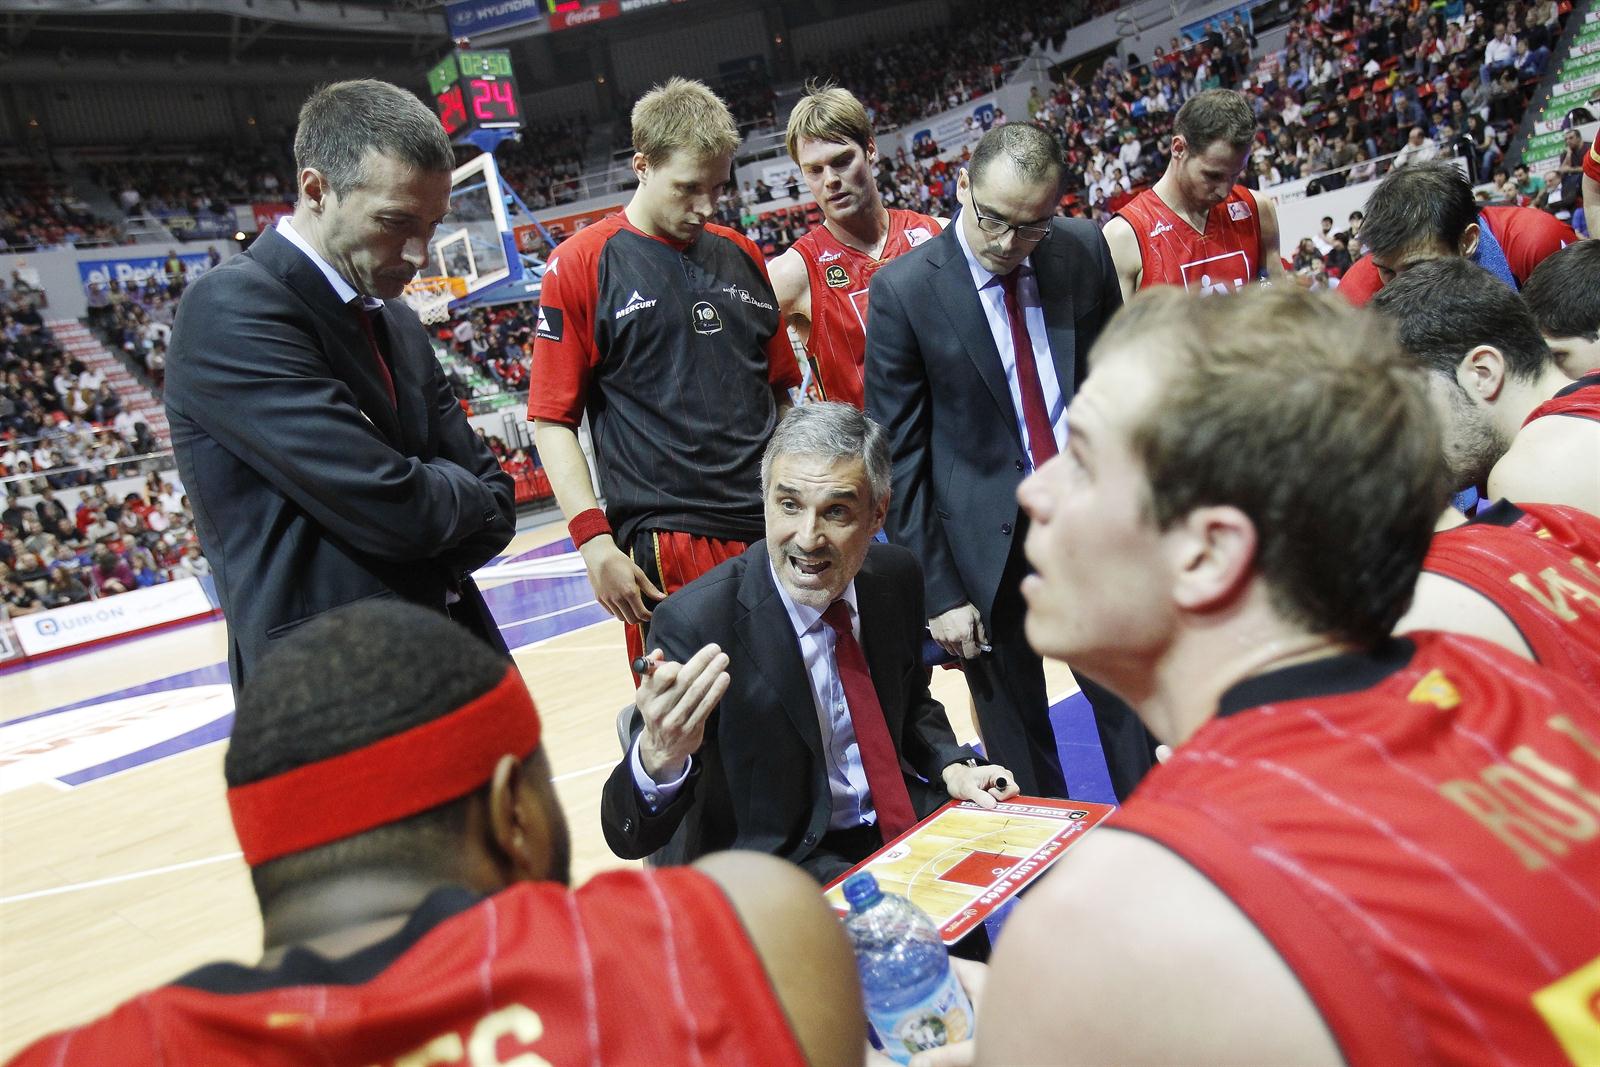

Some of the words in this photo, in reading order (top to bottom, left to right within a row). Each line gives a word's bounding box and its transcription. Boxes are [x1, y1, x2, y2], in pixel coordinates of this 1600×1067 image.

[477, 0, 536, 19] HYUNDAI
[470, 79, 518, 119] 24
[615, 299, 657, 320] MERCURY
[1010, 860, 1038, 880] LUIS
